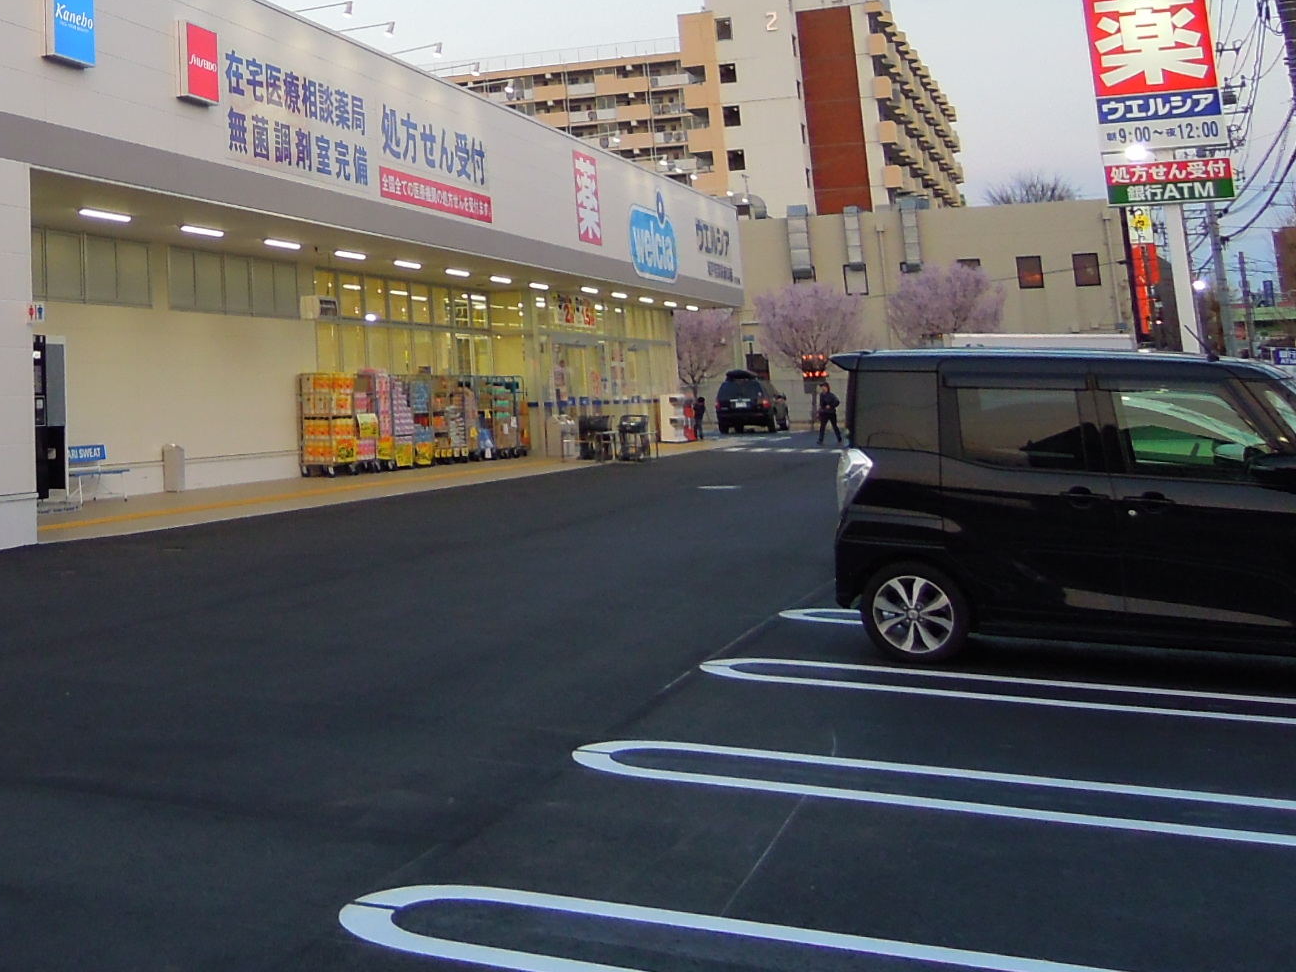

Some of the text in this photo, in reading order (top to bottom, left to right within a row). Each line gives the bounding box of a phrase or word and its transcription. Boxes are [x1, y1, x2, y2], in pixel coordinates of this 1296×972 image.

[55, 2, 93, 30] Kanebo
[765, 11, 778, 32] 2
[189, 53, 217, 73] SHISEIDO
[225, 49, 366, 136] 在宅医療相談薬局
[1102, 93, 1214, 120] ウエルシア
[227, 107, 369, 186] 無菌調剤室完備
[380, 103, 485, 186] 処方せん受付
[1110, 160, 1225, 183] 処方せん受付
[575, 157, 601, 239] 薬
[1127, 181, 1215, 202] 銀行ATM
[632, 204, 674, 272] welcia
[79, 448, 101, 459] SWEAT
